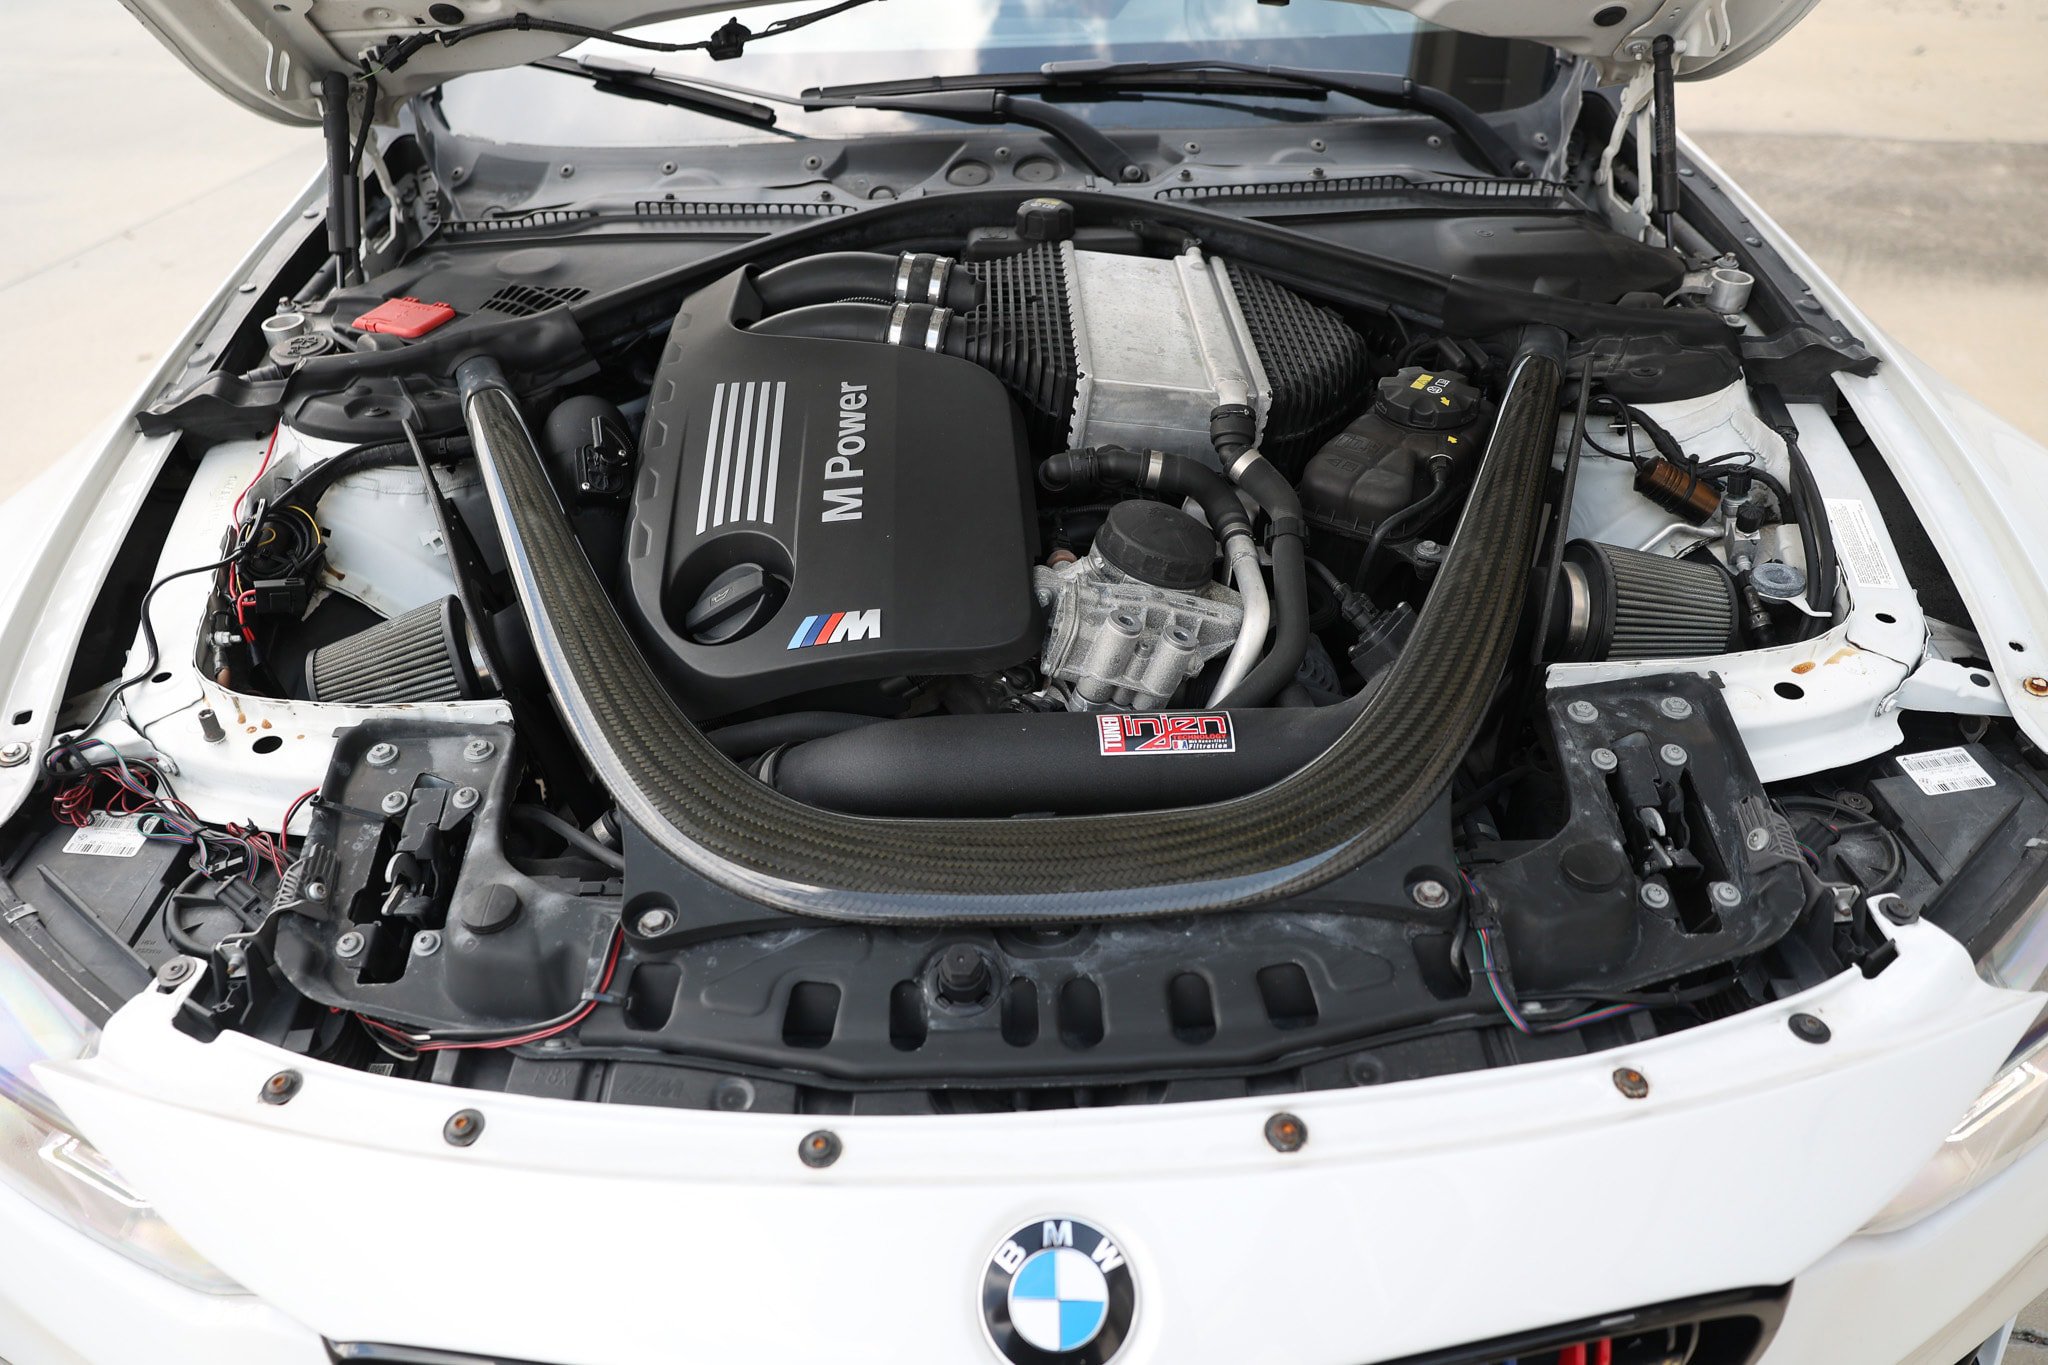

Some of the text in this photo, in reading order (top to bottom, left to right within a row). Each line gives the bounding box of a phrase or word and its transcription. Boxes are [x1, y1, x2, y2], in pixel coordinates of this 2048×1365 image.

[821, 381, 868, 523] M Power
[1122, 713, 1227, 751] injen
[994, 1220, 1125, 1275] BMW
